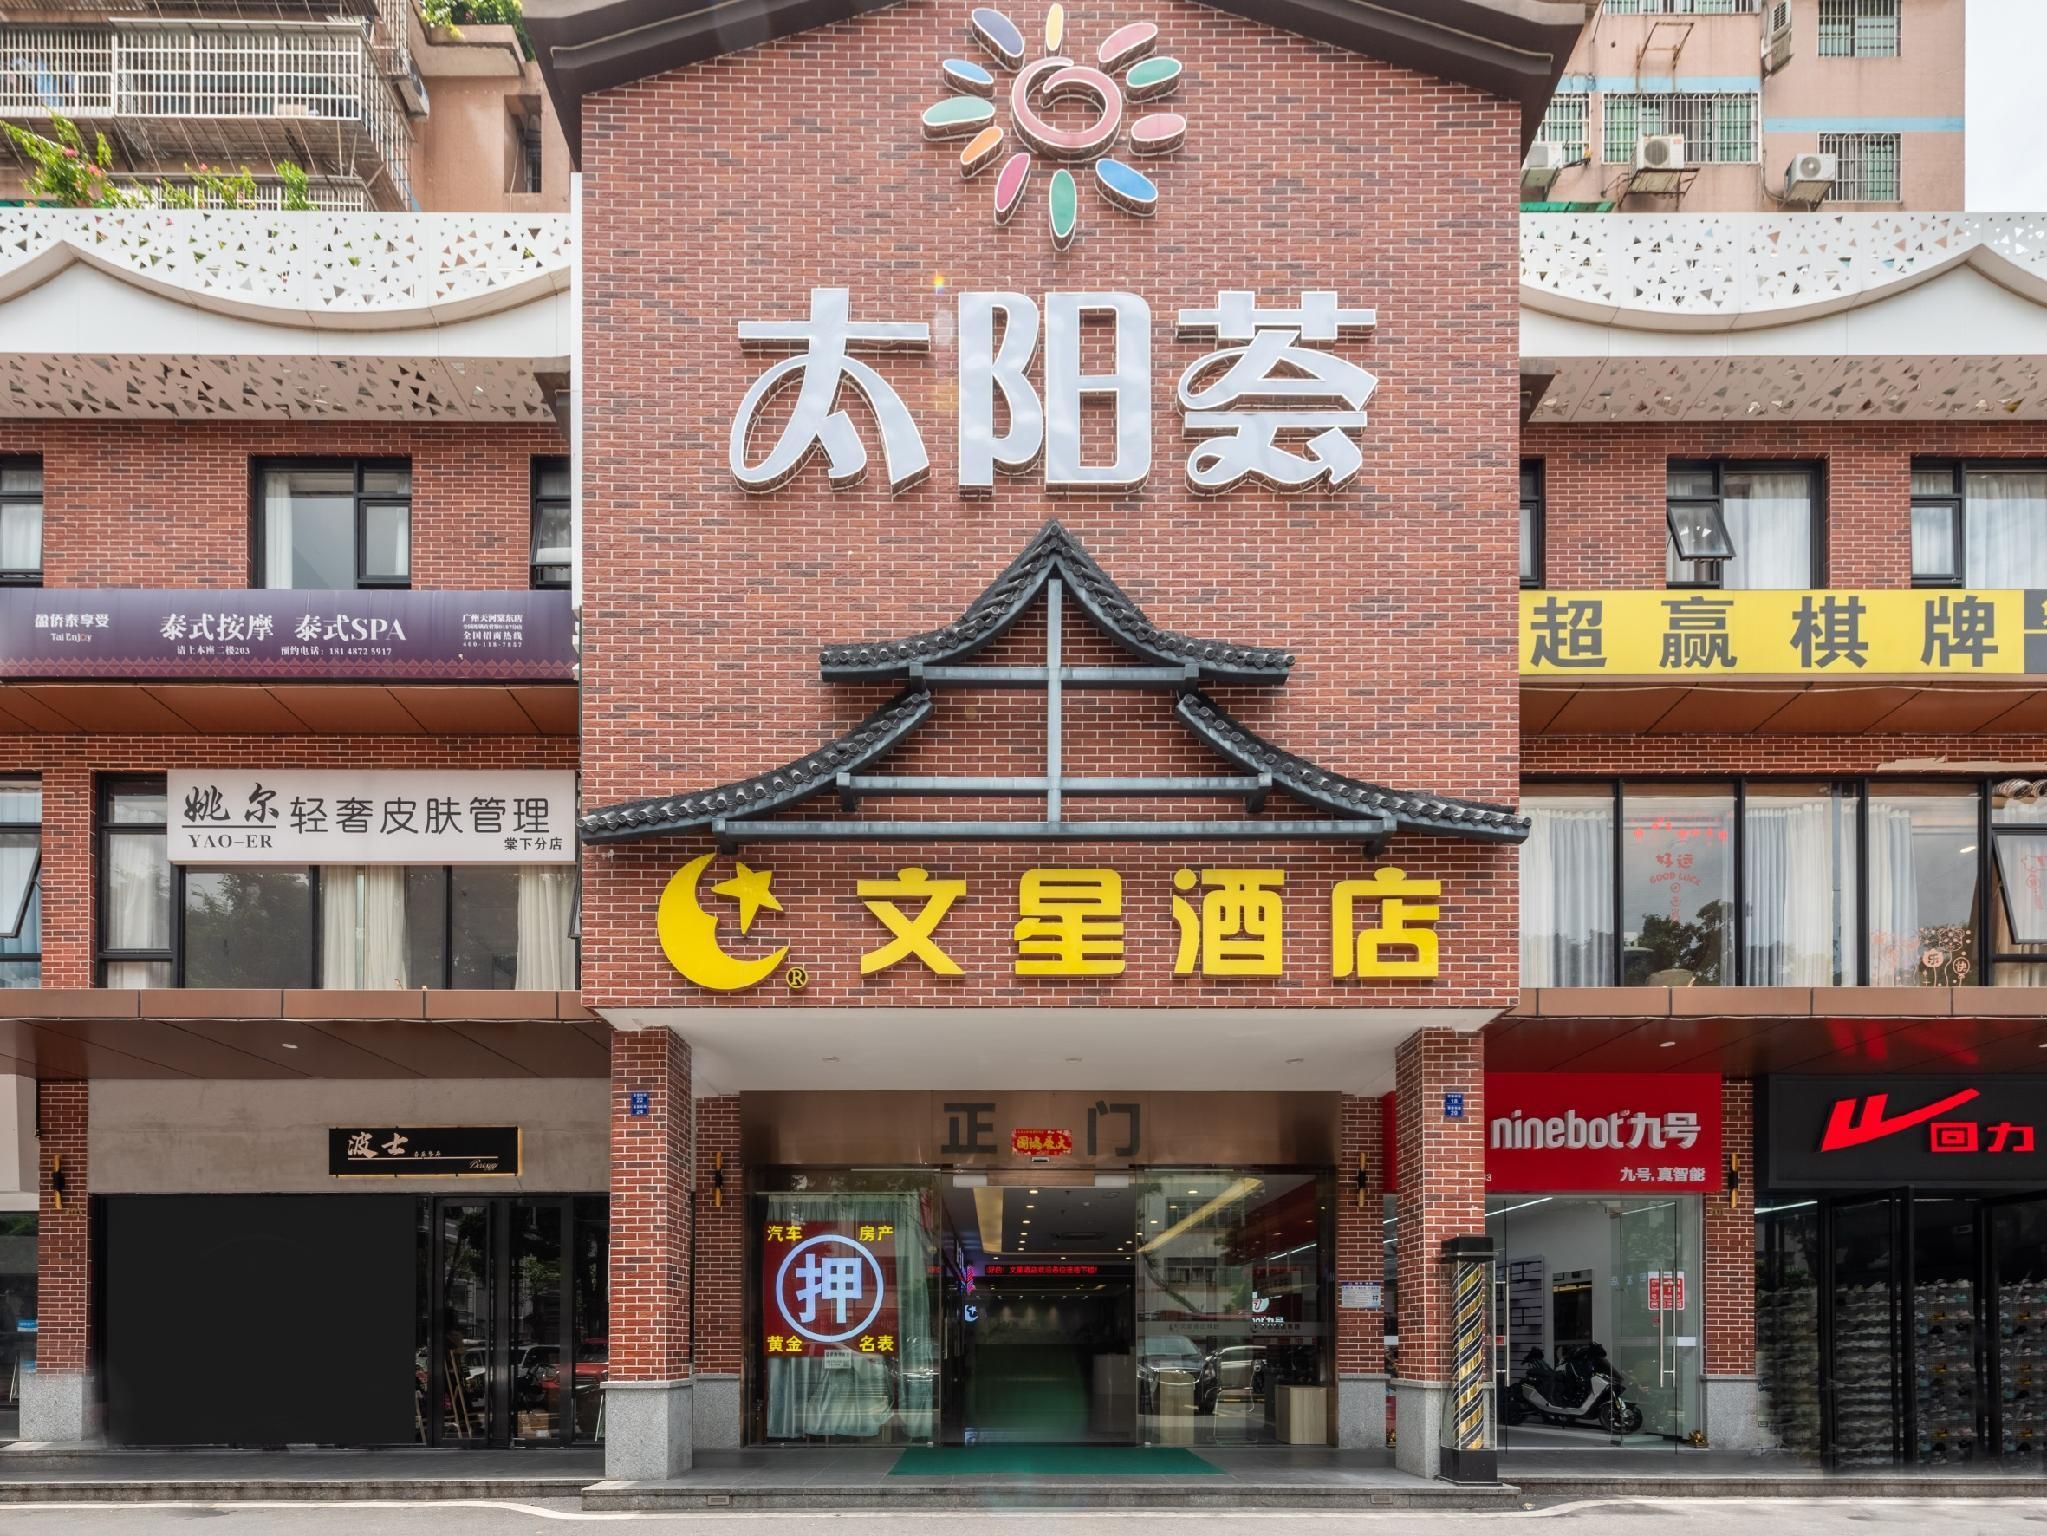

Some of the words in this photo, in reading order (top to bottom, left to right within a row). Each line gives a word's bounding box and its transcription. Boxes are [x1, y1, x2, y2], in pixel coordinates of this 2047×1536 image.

[730, 287, 1379, 495] 太阳荟
[160, 613, 274, 641] 泰式按摩
[294, 613, 406, 641] 泰式SPA
[1529, 596, 1998, 667] 超赢棋牌
[184, 782, 279, 823] 姚尔
[290, 796, 550, 834] 轻奢皮肤管理
[187, 834, 273, 849] YAO-ER
[504, 837, 563, 851] 棠下分店
[857, 867, 1442, 979] 文星酒店
[941, 1101, 1141, 1156] 正门
[1930, 1122, 2035, 1152] 回力
[348, 1132, 408, 1158] 波士
[767, 1225, 803, 1241] 汽车
[859, 1225, 894, 1241] 房产
[795, 1253, 862, 1324] 押
[767, 1335, 803, 1352] 黄金
[859, 1335, 894, 1352] 名表
